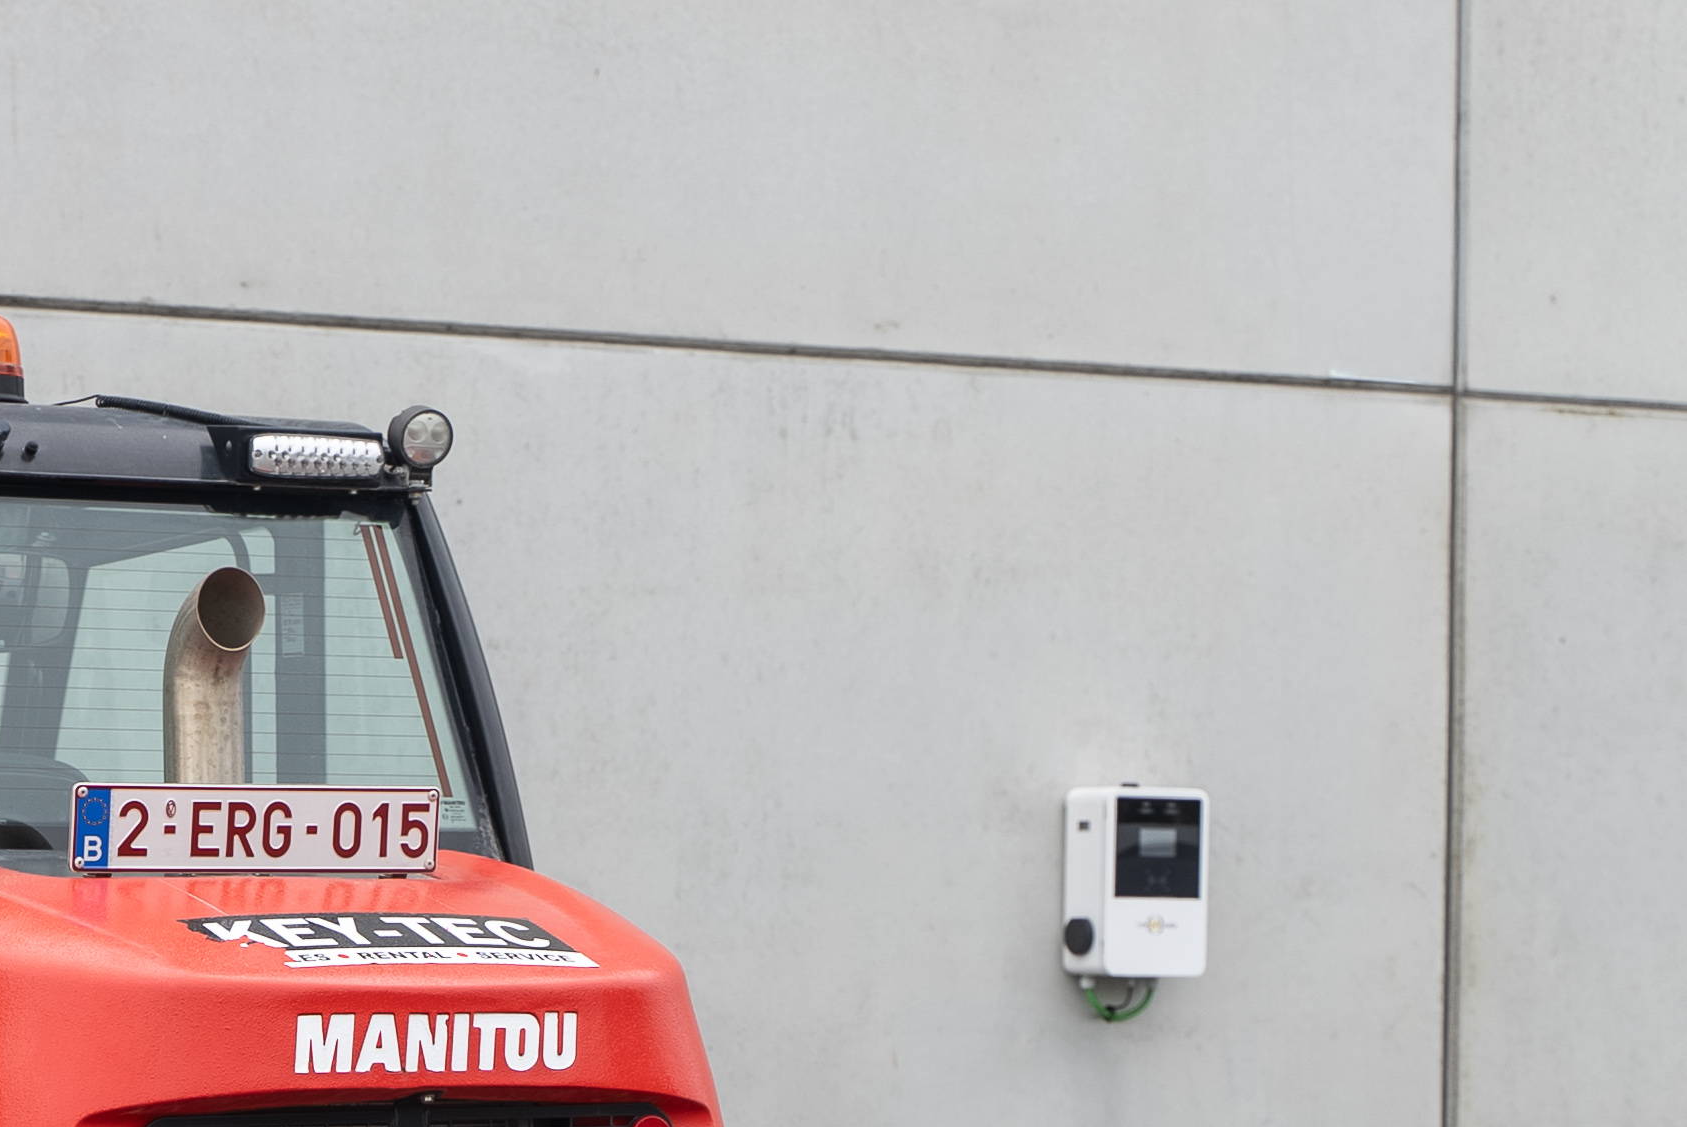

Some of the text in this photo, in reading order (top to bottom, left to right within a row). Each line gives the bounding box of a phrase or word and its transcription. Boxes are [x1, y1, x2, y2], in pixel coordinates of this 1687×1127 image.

[83, 835, 103, 862] B
[116, 800, 431, 858] 2-ERG-015
[202, 916, 551, 949] KEY-TEC
[356, 951, 452, 960] RENTAL
[476, 951, 576, 963] SERVICE
[294, 1012, 578, 1074] MANITOU
